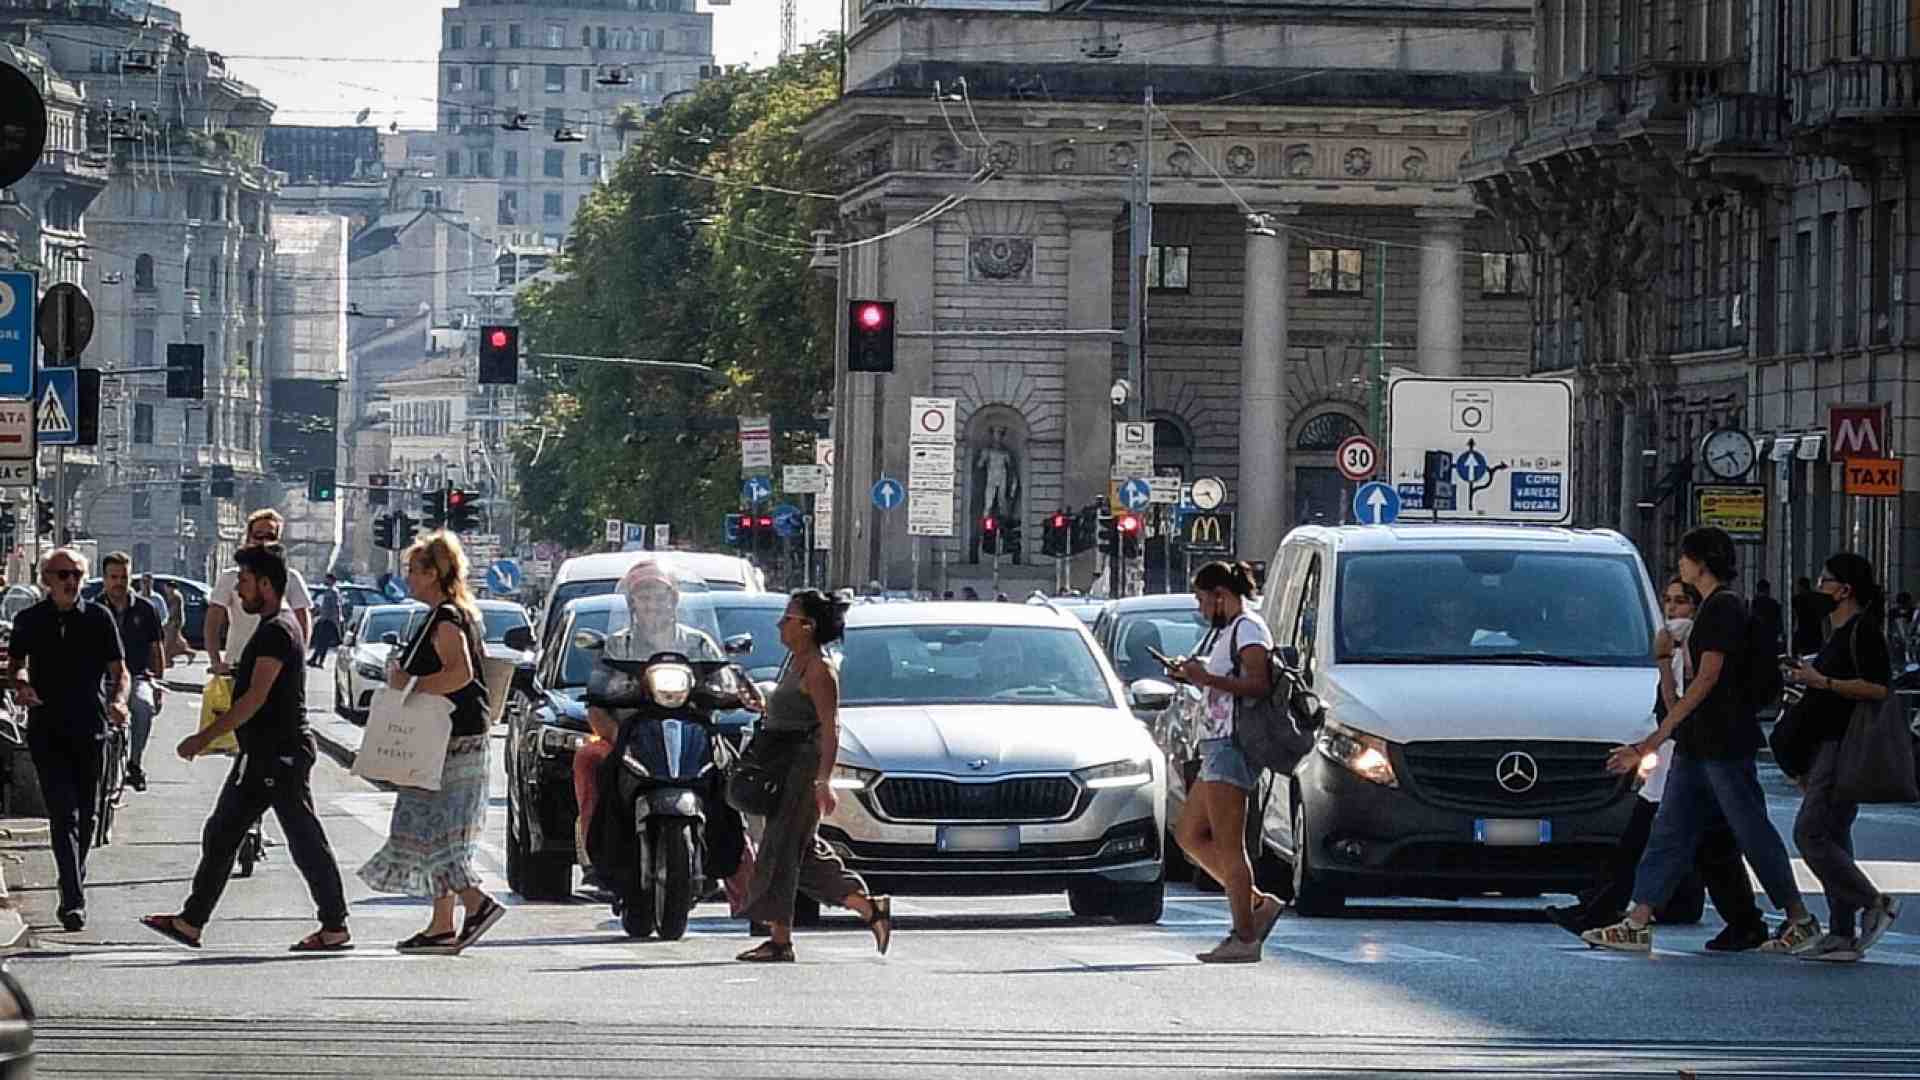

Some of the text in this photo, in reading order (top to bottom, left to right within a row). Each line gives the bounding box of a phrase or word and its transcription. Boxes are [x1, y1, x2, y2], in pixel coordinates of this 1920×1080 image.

[1834, 418, 1879, 451] M
[1348, 448, 1369, 467] 30
[1526, 474, 1559, 484] COMO
[1850, 467, 1897, 485] TAXI
